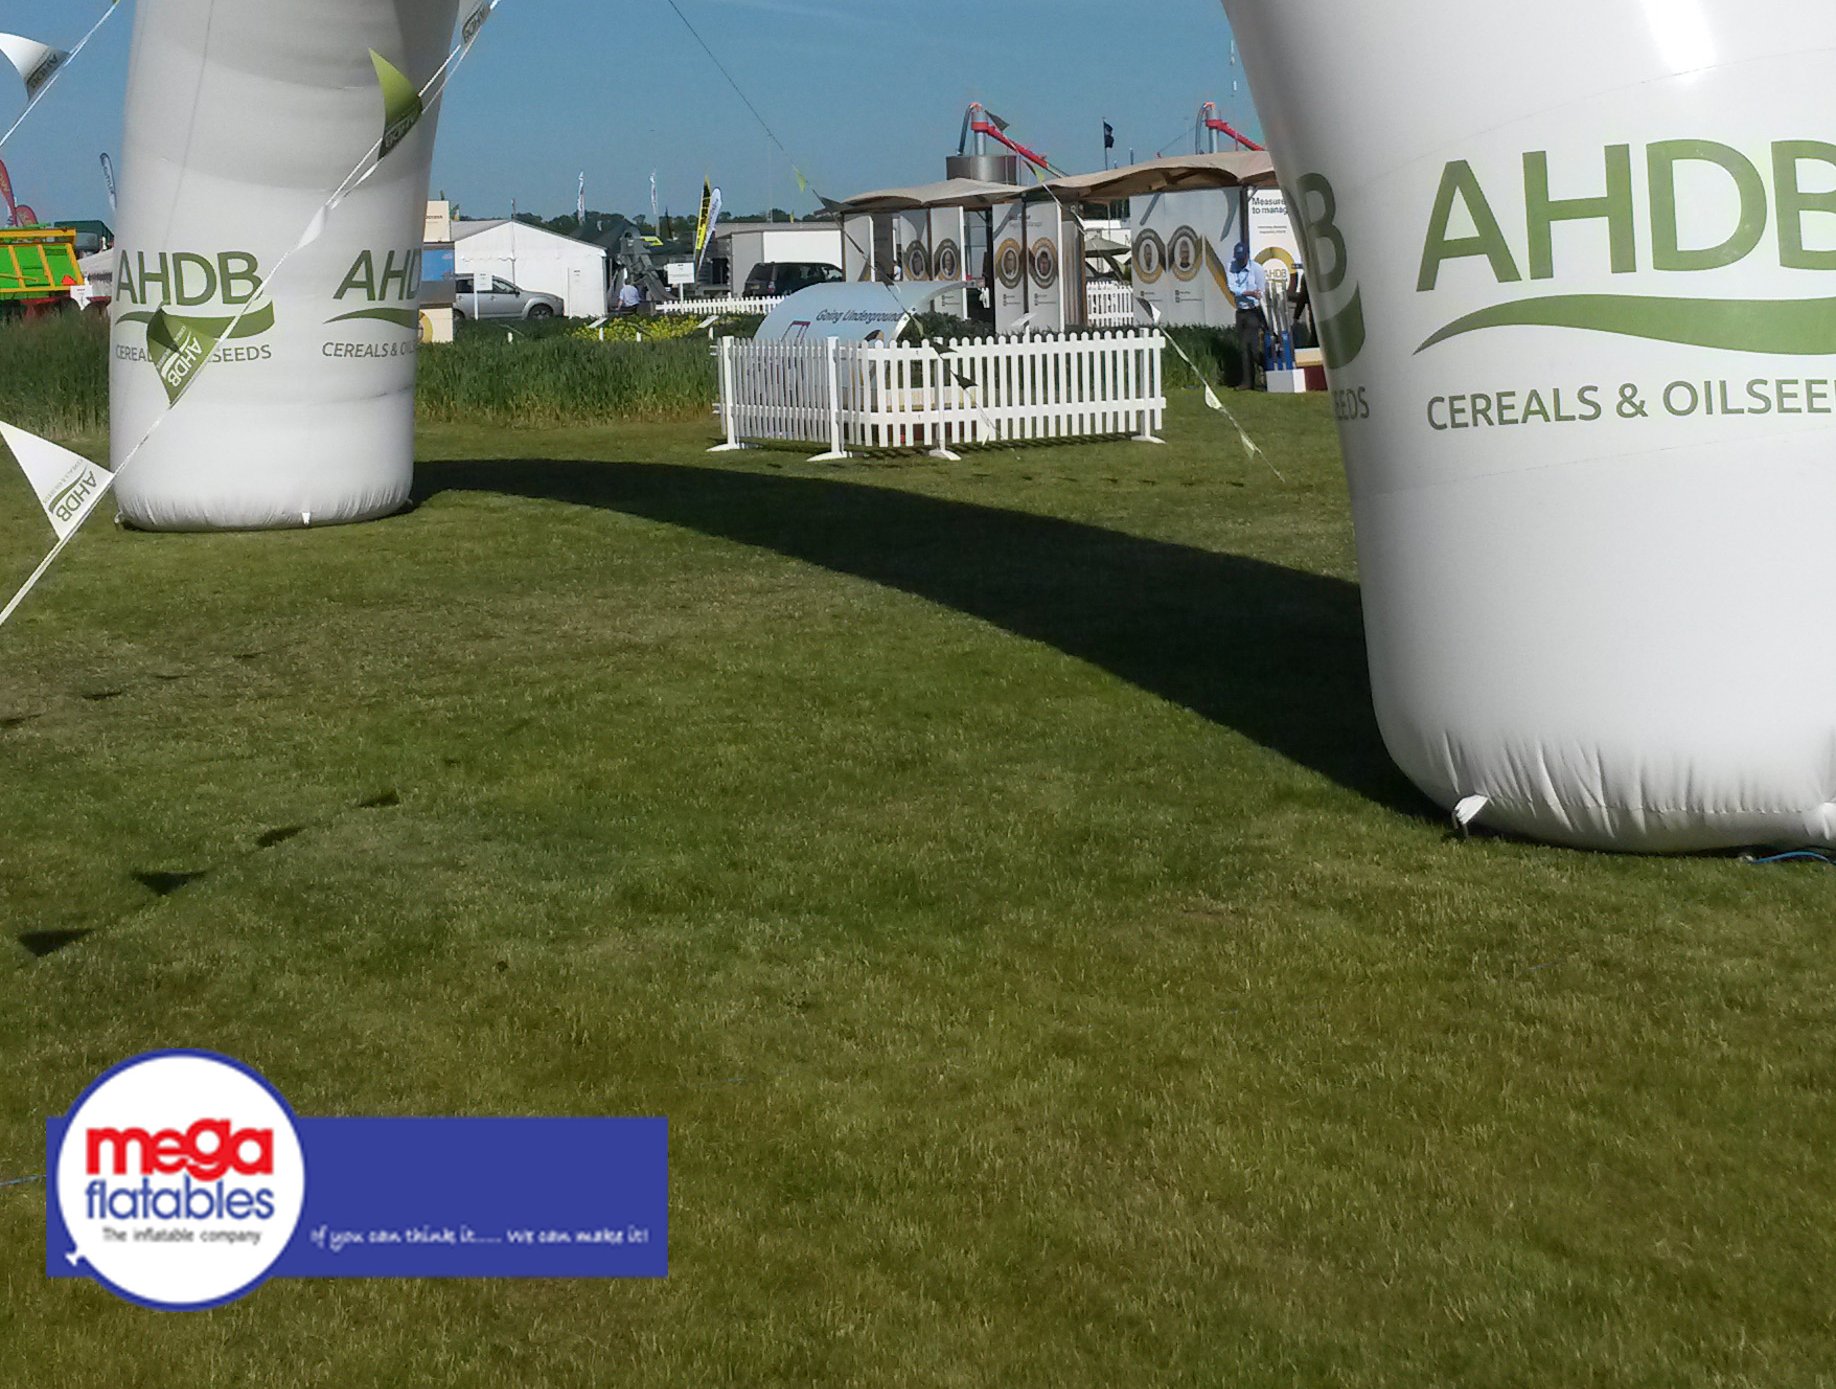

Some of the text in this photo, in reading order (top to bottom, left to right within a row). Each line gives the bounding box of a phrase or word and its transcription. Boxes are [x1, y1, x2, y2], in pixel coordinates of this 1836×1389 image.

[116, 250, 264, 306] AHDB
[815, 308, 843, 324] Going
[167, 337, 203, 387] AHDB
[322, 341, 389, 358] CEREALS
[1427, 378, 1836, 431] CEREALS & OILSEE
[55, 470, 97, 522] AHDB
